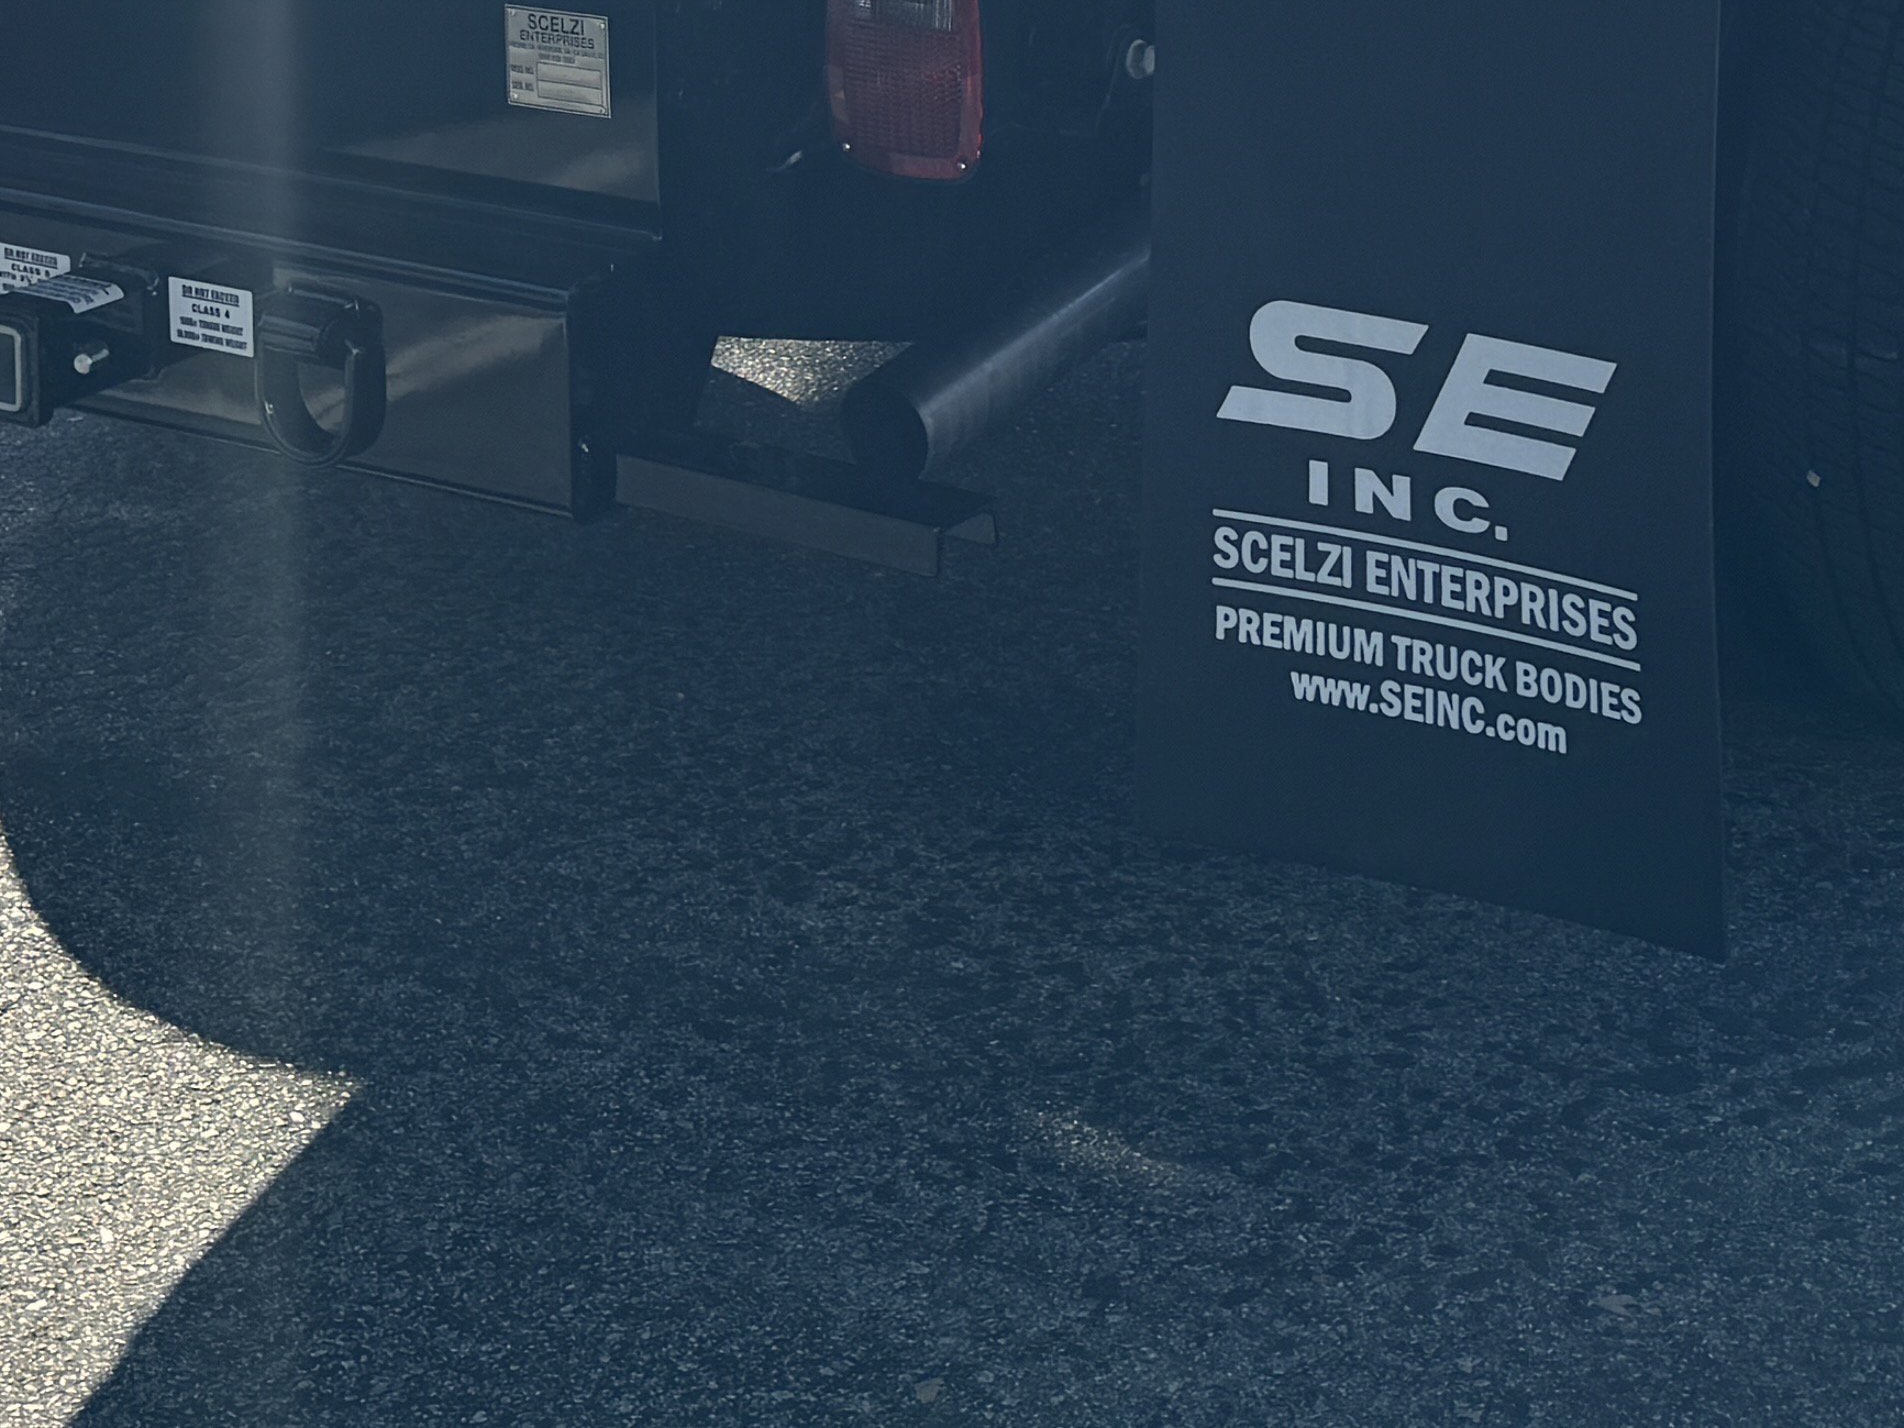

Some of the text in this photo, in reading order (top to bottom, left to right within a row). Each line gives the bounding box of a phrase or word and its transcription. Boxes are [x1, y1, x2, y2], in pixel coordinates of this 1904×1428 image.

[519, 29, 595, 50] ENTERPRISES
[527, 13, 585, 36] SCELZI
[191, 303, 221, 318] CLASS
[1216, 300, 1618, 481] SE
[1307, 459, 1509, 542] INC.
[1212, 526, 1638, 651] SCELZI ENTERPRISES
[1215, 604, 1643, 725] PREMIUM TRUCK BODIES
[1290, 671, 1568, 755] www.SEINC.com
